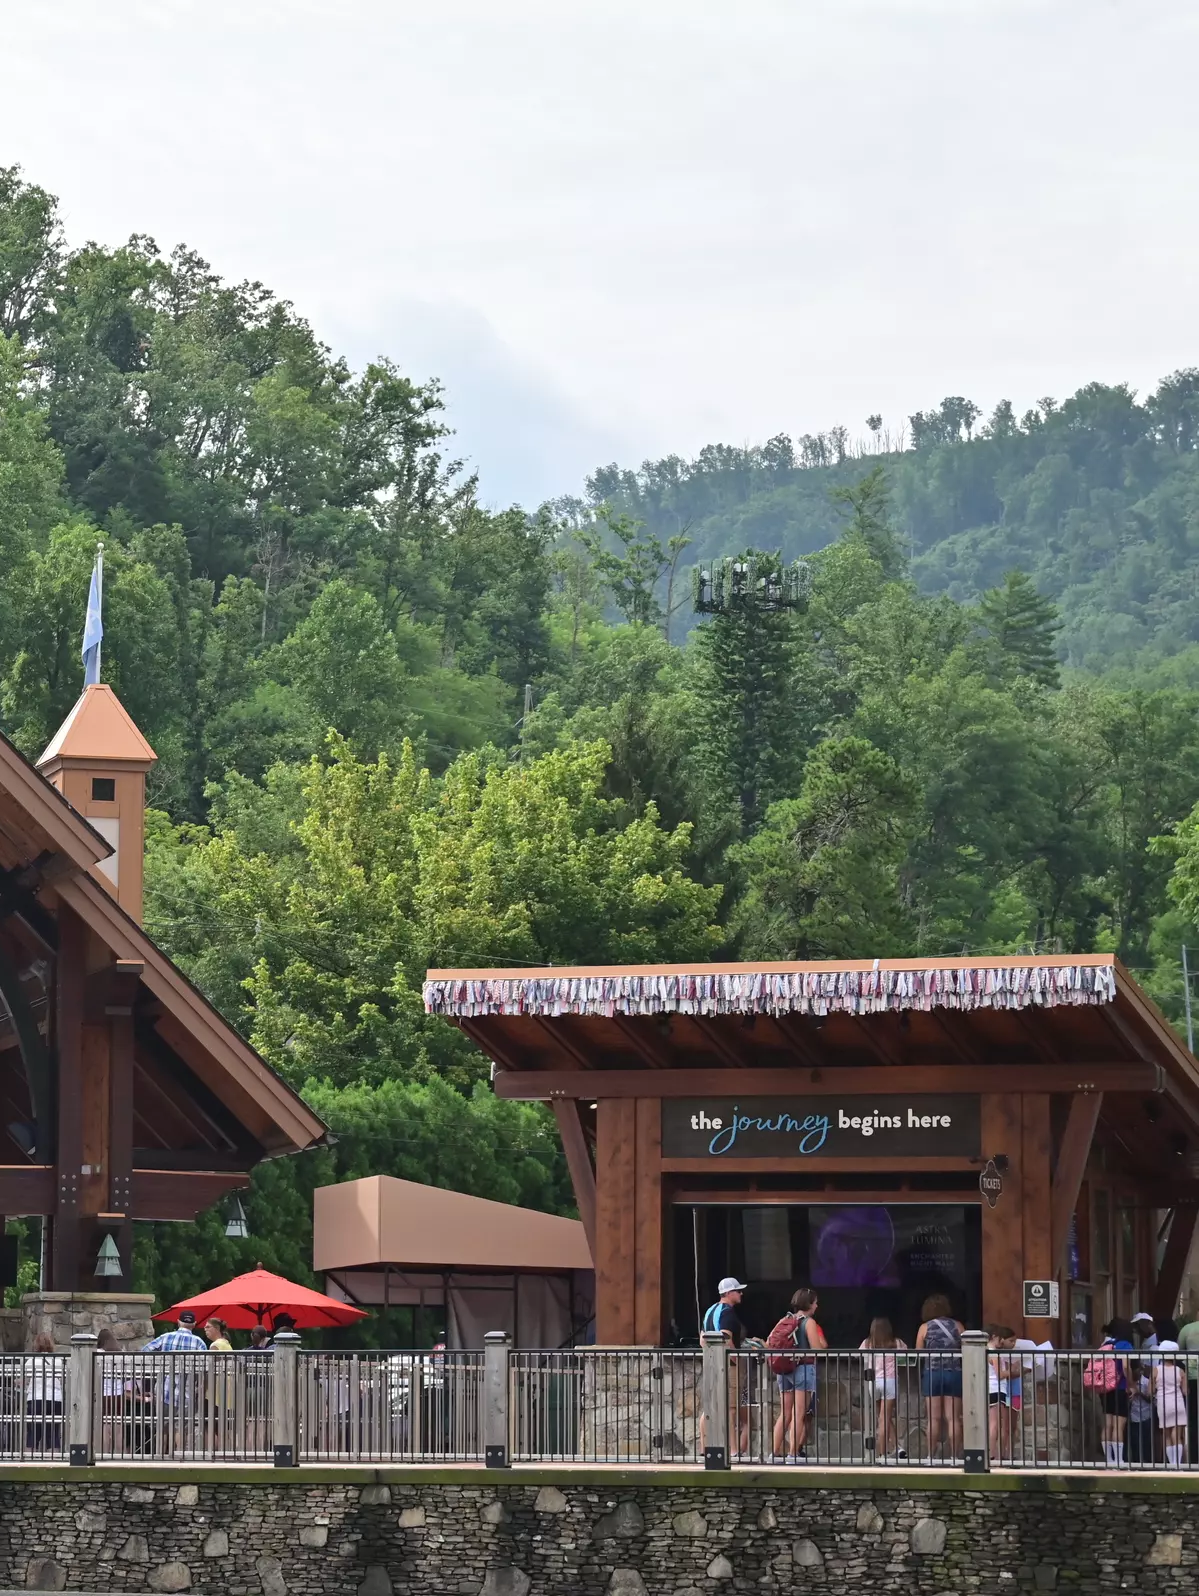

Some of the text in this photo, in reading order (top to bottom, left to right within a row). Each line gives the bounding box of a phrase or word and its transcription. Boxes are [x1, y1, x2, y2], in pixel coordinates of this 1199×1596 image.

[690, 1105, 952, 1155] the journey begins here
[982, 1178, 1001, 1190] TICKETS
